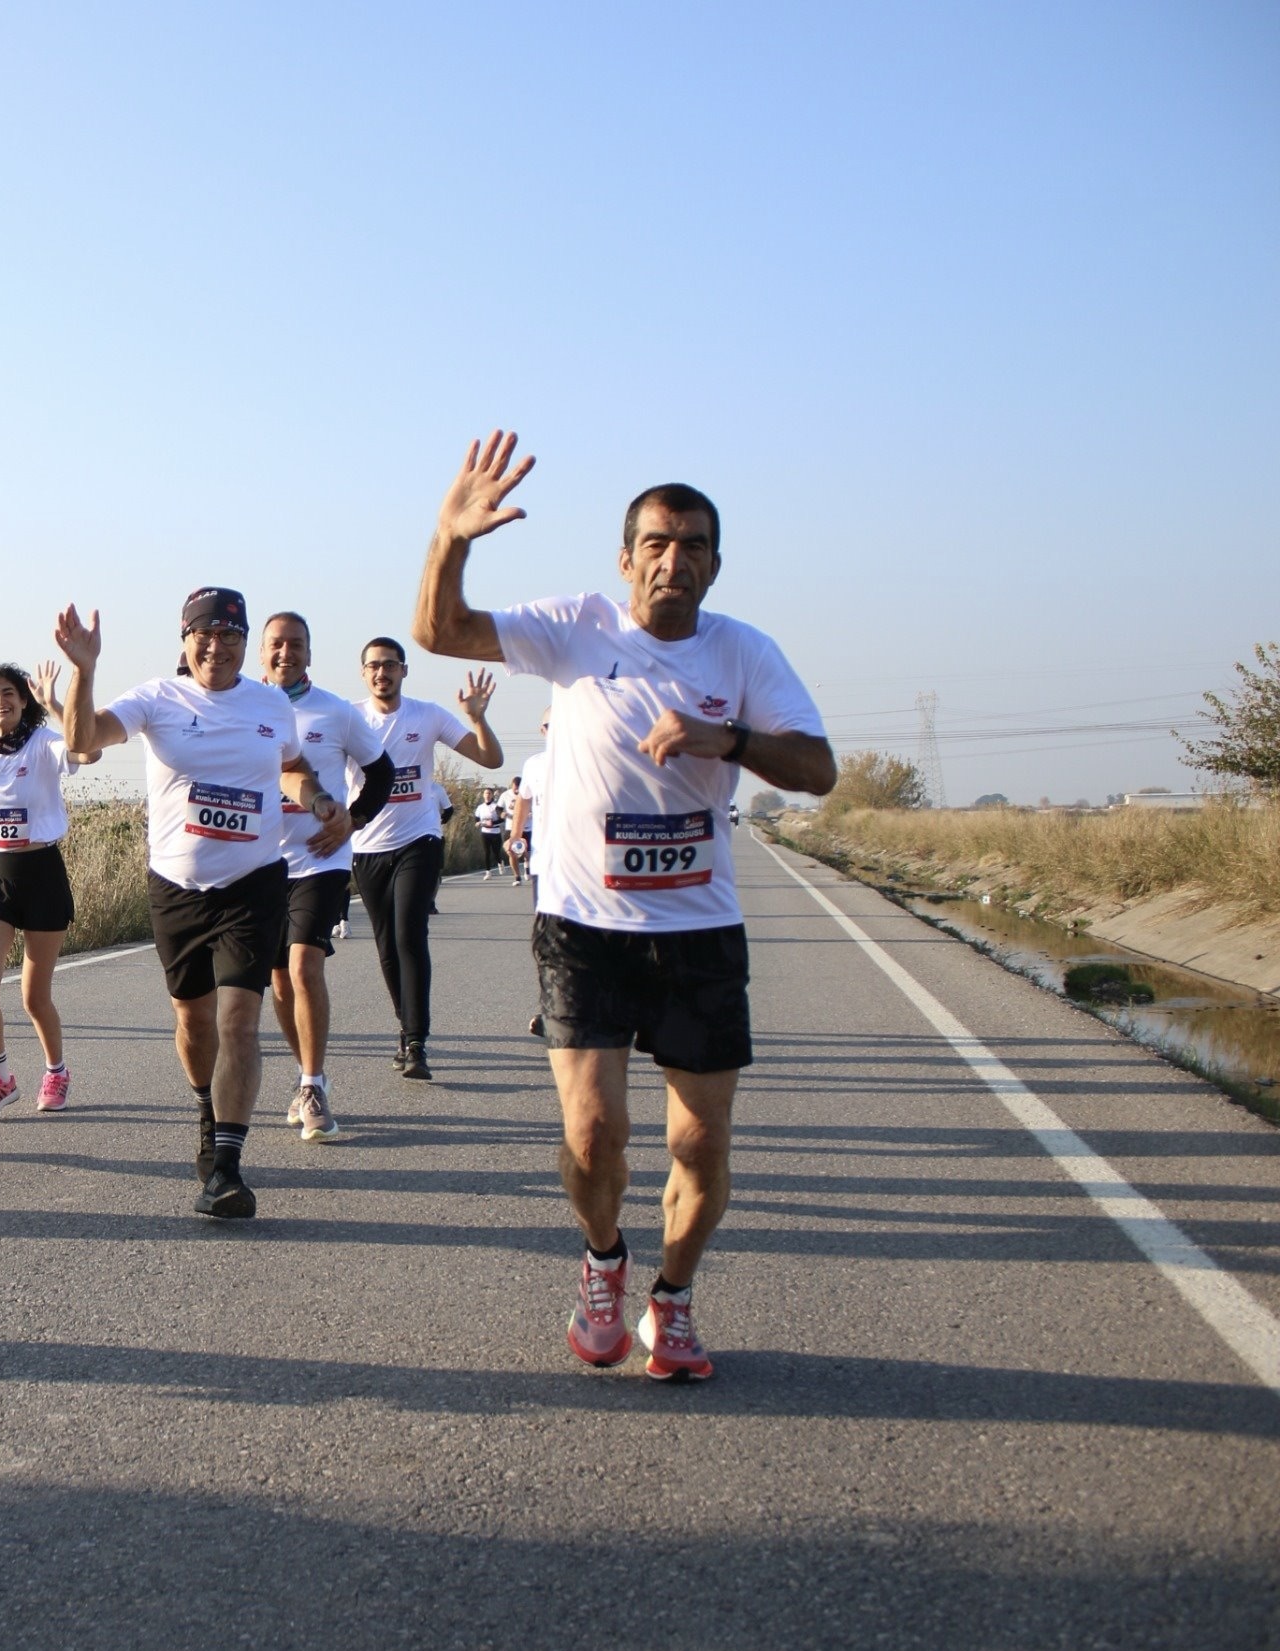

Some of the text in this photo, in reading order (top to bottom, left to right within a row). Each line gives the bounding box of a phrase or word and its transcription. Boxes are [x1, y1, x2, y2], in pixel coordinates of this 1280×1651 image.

[392, 781, 414, 794] 201
[199, 808, 248, 831] 0061
[616, 828, 705, 840] KUBİLAY YOL KOŞUSU
[624, 845, 697, 873] 0199
